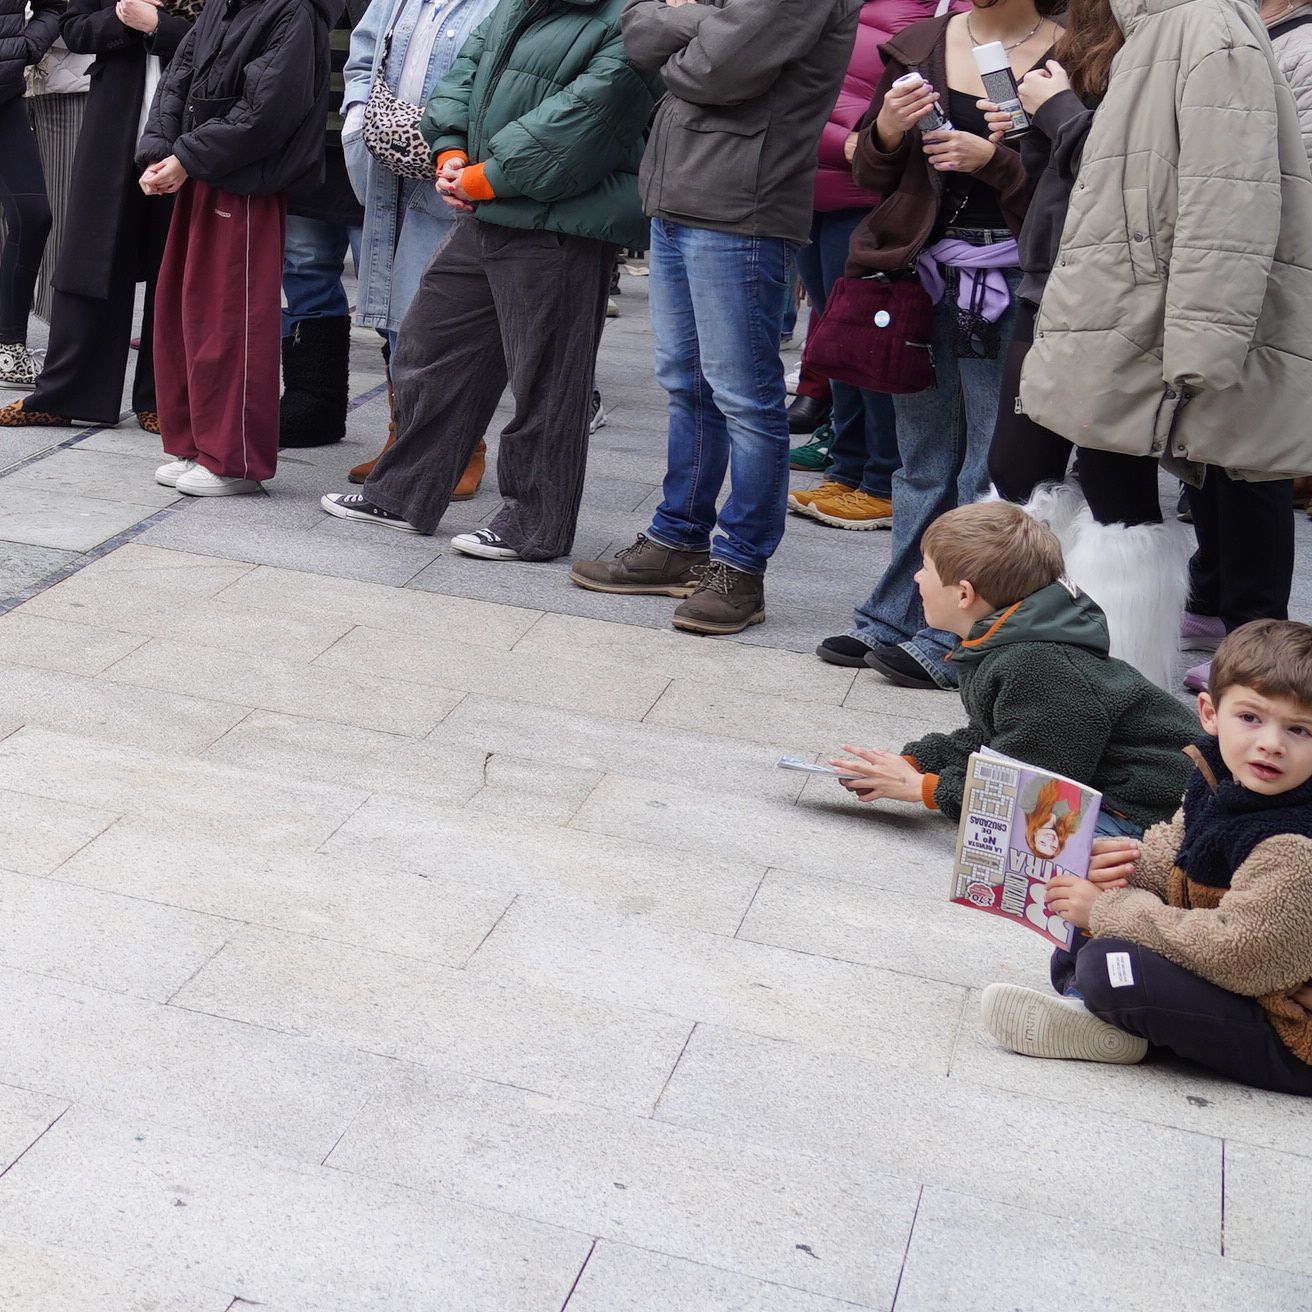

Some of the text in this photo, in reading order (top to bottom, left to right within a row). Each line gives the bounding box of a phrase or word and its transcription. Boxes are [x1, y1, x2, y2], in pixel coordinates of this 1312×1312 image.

[970, 815, 1007, 832] CRUZADAS
[981, 827, 992, 835] DE
[968, 840, 1002, 854] LA REVISTA
